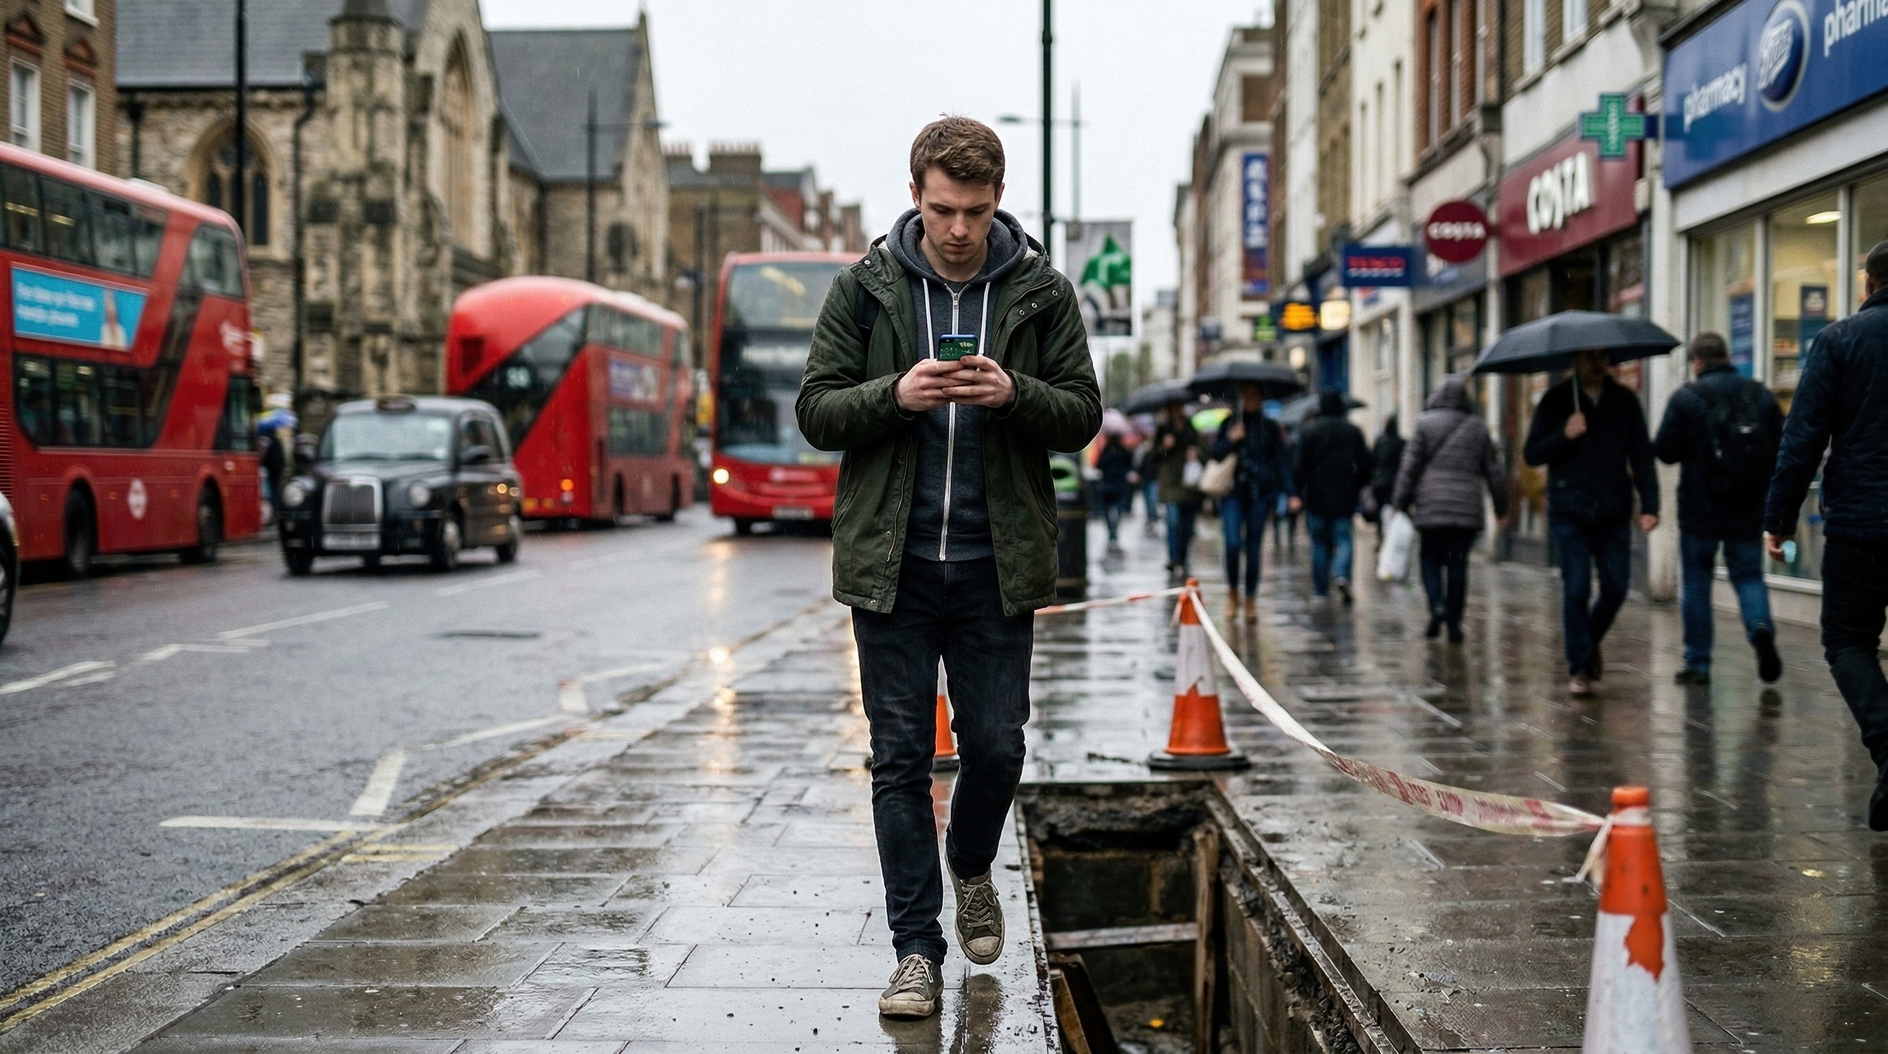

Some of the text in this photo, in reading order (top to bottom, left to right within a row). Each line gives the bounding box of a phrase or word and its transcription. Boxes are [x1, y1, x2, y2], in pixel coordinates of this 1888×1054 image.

[1683, 61, 1747, 134] pharmacy
[1527, 151, 1592, 235] COSTA
[1427, 221, 1487, 242] COSTA
